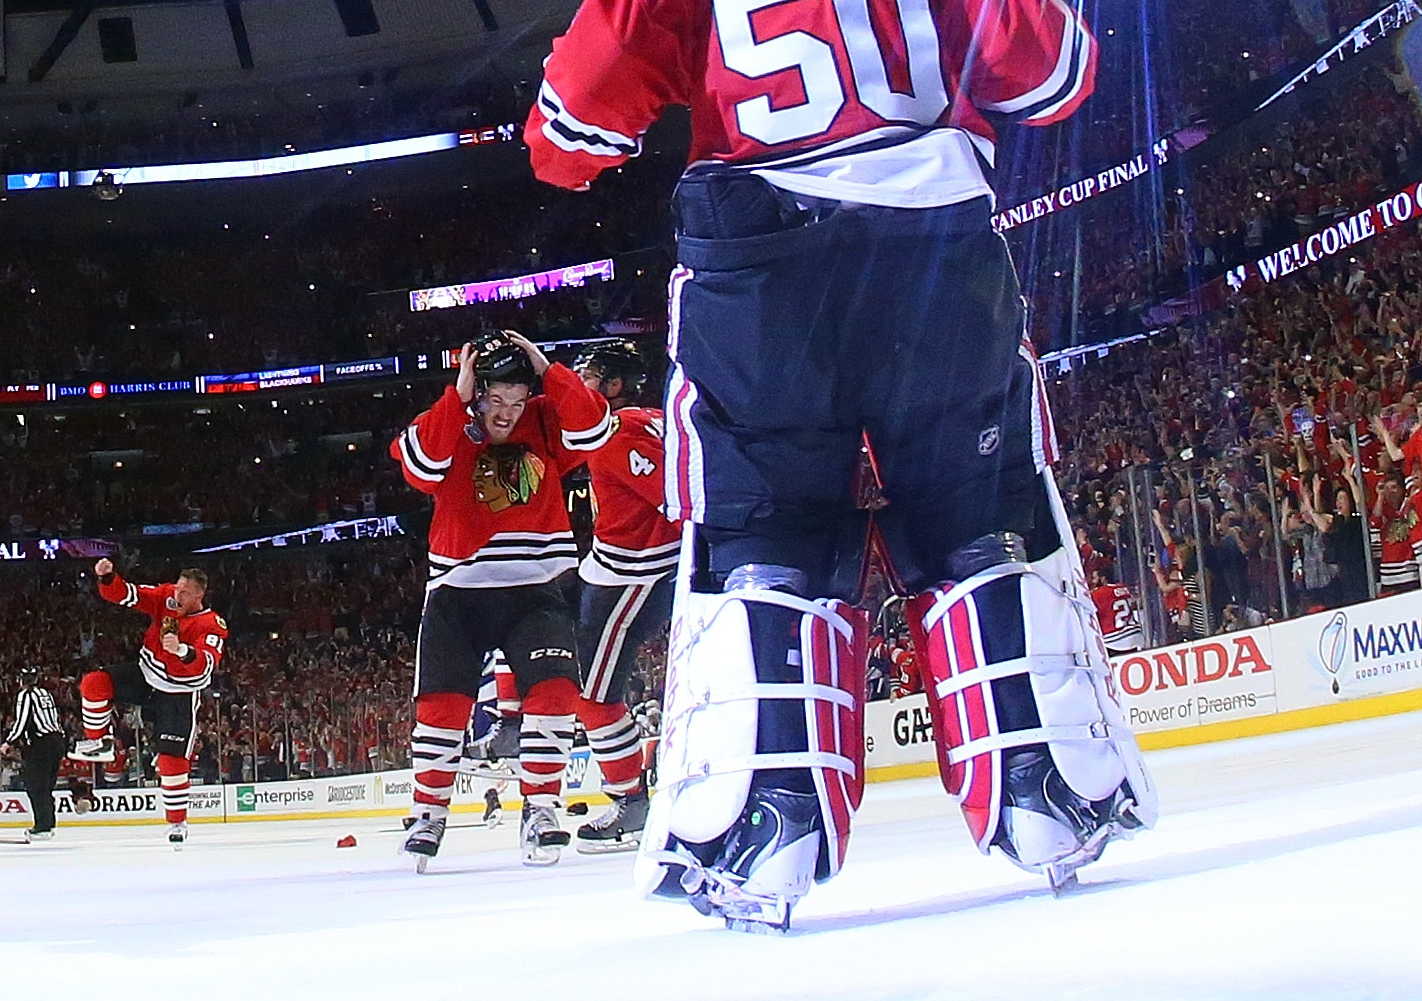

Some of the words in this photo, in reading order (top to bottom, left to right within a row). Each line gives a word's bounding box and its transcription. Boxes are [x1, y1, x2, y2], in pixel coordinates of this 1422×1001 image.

[1058, 177, 1095, 206] CUP
[1098, 154, 1149, 192] FINAL
[1257, 208, 1376, 283] WELCOME
[1377, 191, 1412, 229] TO
[60, 386, 86, 396] BMO
[109, 382, 156, 394] HARRIS
[158, 380, 191, 391] CLUB
[629, 449, 656, 477] 4
[206, 633, 224, 655] 81
[530, 647, 573, 661] CCM
[1355, 667, 1379, 680] GOOD
[1380, 665, 1393, 675] TO
[1394, 661, 1413, 673] THE
[1129, 701, 1176, 726] Power
[1178, 699, 1193, 717] of
[1197, 691, 1257, 715] Dreams
[567, 757, 588, 783] SAP
[241, 788, 315, 807] enterprise
[384, 781, 413, 796] McDonald's
[188, 799, 203, 810] THE
[204, 798, 221, 809] APP
